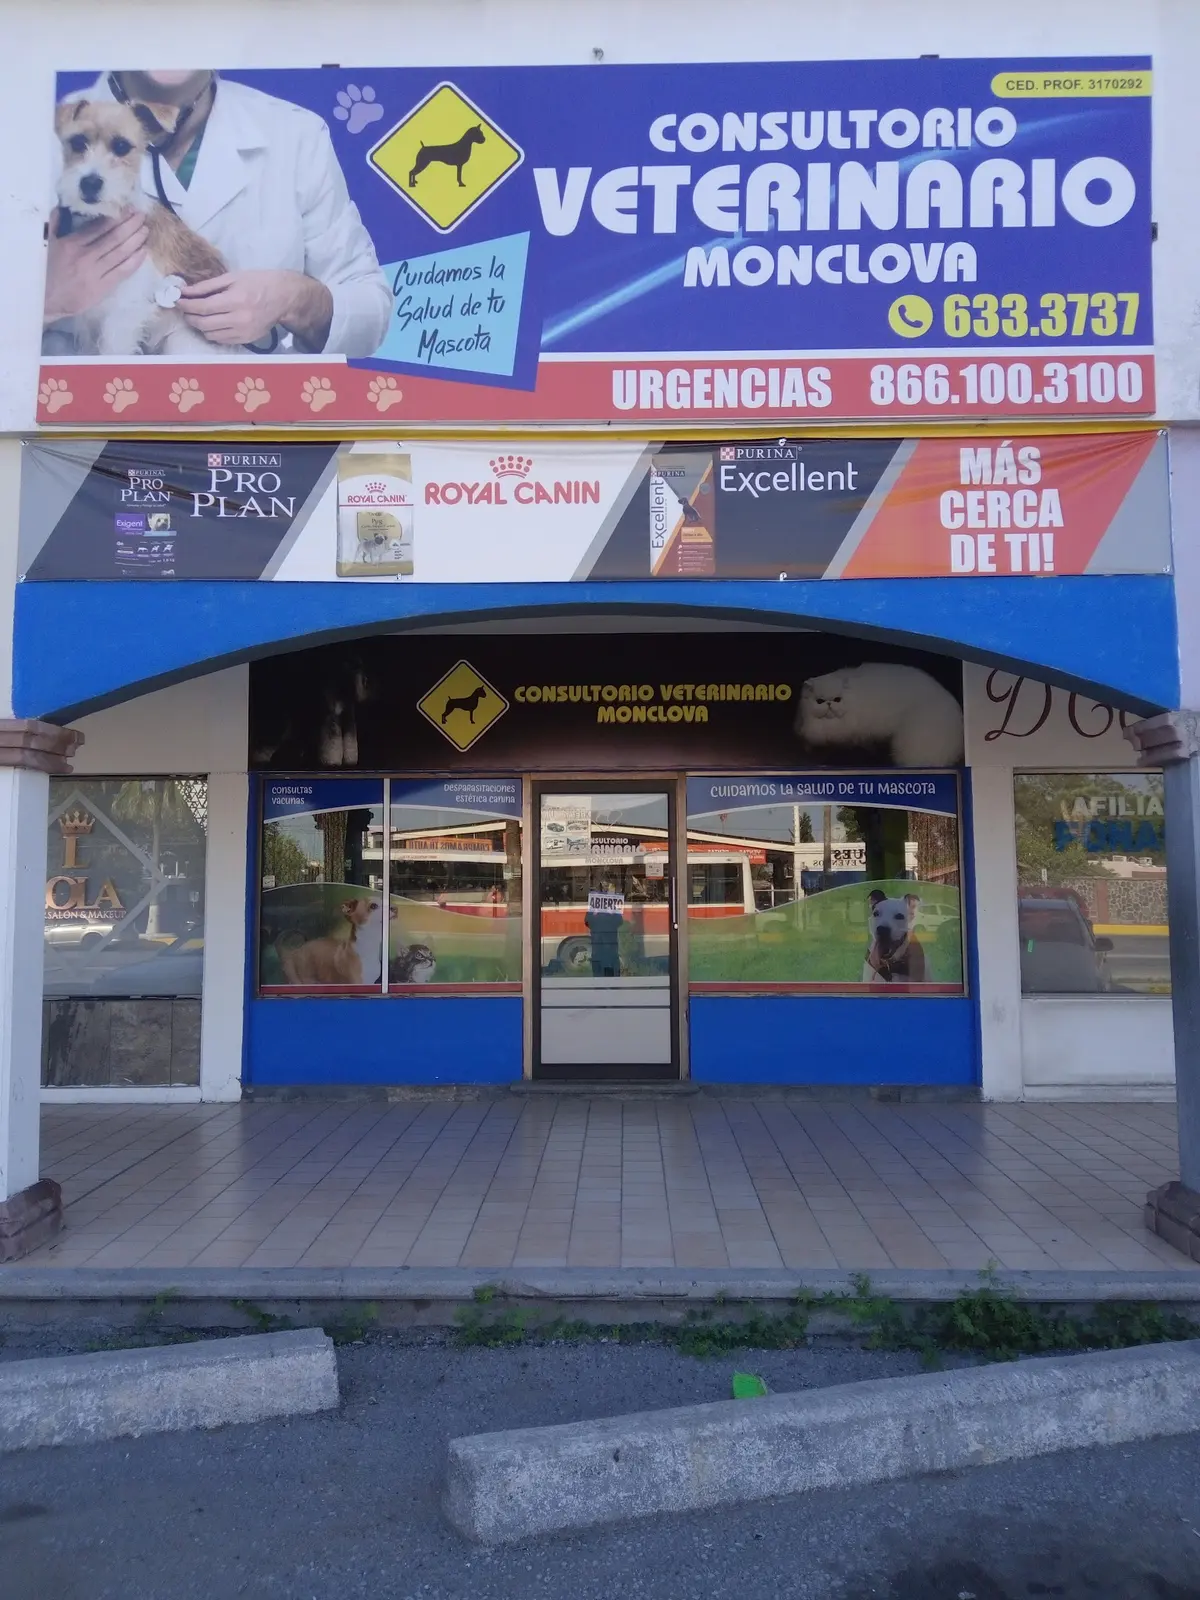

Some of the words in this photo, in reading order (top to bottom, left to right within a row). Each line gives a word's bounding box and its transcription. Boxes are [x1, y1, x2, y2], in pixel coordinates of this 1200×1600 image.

[1006, 79, 1039, 91] CED.
[1043, 79, 1084, 90] PROF.
[1088, 78, 1143, 89] 3170292
[649, 107, 1017, 153] CONSULTORIO
[533, 156, 1136, 236] VETERINARIO
[393, 260, 482, 297] Cuidamos
[489, 255, 506, 282] la
[683, 242, 977, 288] MONCLOVA
[397, 294, 454, 331] Salud
[460, 293, 482, 316] de
[487, 288, 505, 313] tu
[943, 292, 1140, 338] 633.3737
[417, 324, 492, 364] Mascota
[612, 366, 832, 410] URGENCIAS
[870, 362, 1143, 405] 866.100.3100
[223, 455, 279, 465] PURINA
[737, 448, 795, 459] PURINA
[960, 440, 1041, 486] MÁS
[120, 489, 171, 502] PLAN
[129, 477, 164, 491] PRO
[207, 468, 281, 493] PRO
[425, 481, 508, 505] ROYAL
[514, 480, 600, 504] CANIN
[720, 462, 859, 498] Excellent
[189, 492, 297, 518] PLAN
[347, 494, 375, 504] ROYAL
[377, 493, 406, 503] CANIN
[650, 479, 668, 548] Excellent
[940, 488, 1065, 529] CERCA
[116, 519, 143, 528] Exigent
[951, 533, 997, 573] DE
[1004, 533, 1055, 572] TI!
[514, 685, 655, 702] CONSULTORIO
[660, 684, 792, 701] VETERINARIO
[597, 706, 709, 723] MONCLOVA
[45, 876, 125, 910] OLA
